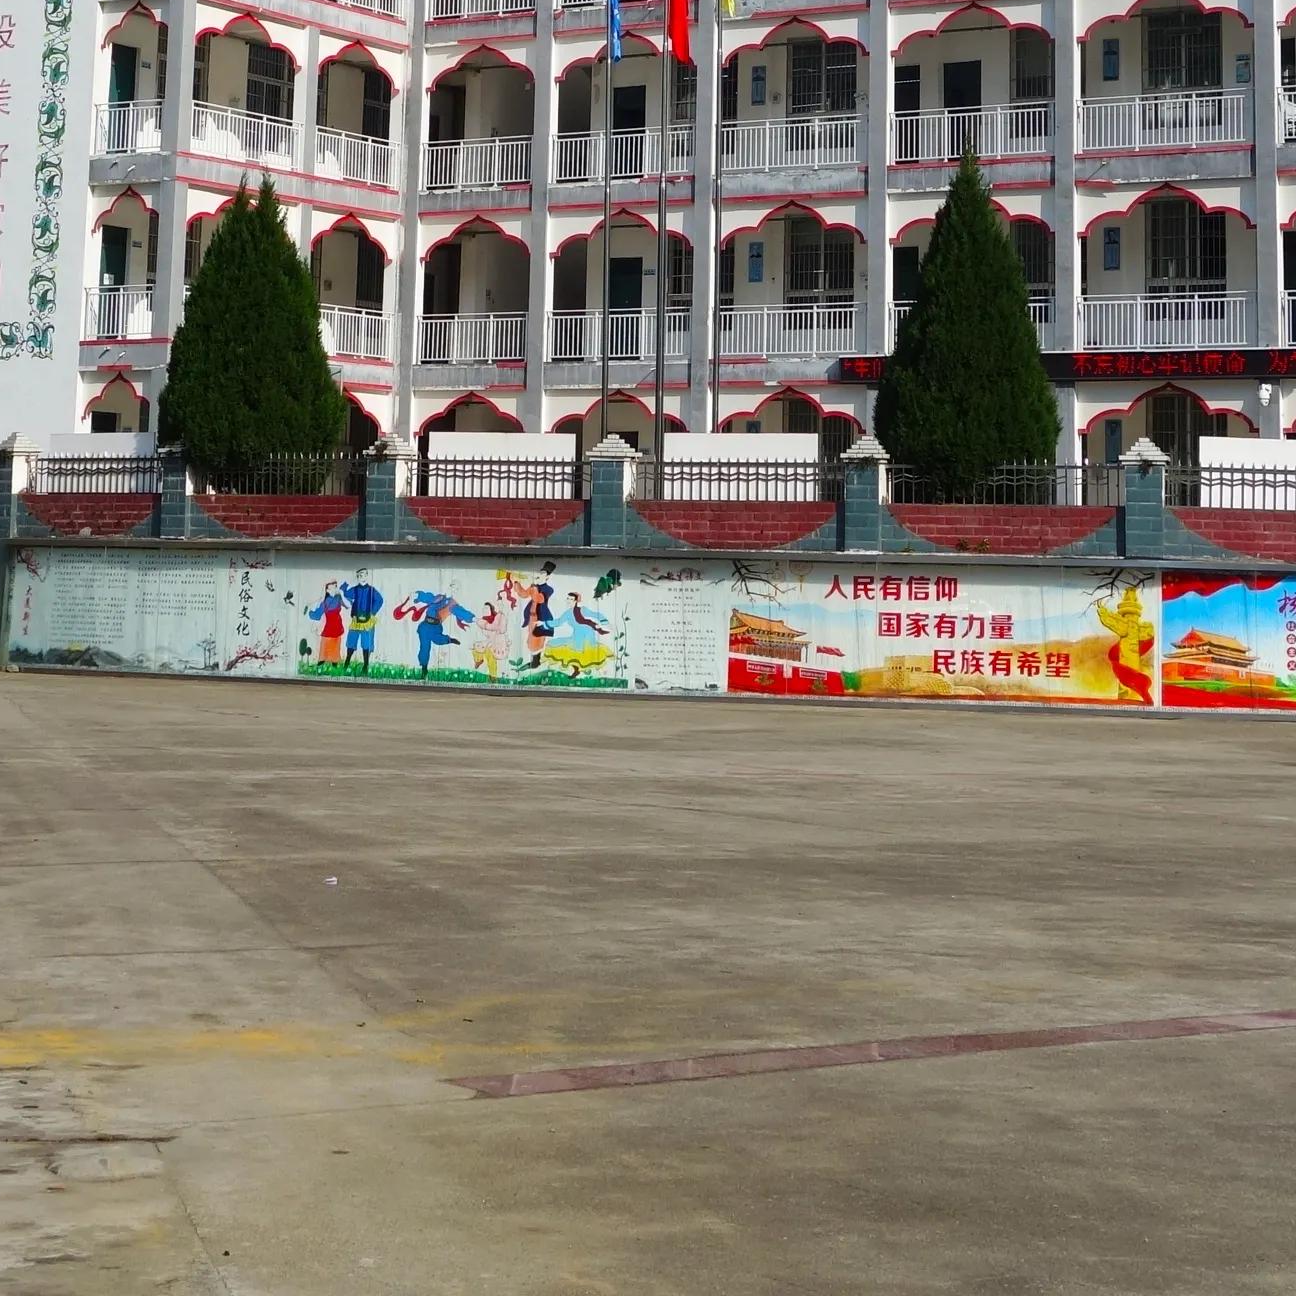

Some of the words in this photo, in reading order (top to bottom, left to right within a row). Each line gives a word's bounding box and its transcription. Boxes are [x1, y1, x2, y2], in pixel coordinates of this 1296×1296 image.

[825, 574, 958, 601] 人民有信仰
[237, 571, 254, 636] 民俗文化
[878, 612, 1014, 639] 国家有力量
[933, 649, 1071, 678] 民族有希望
